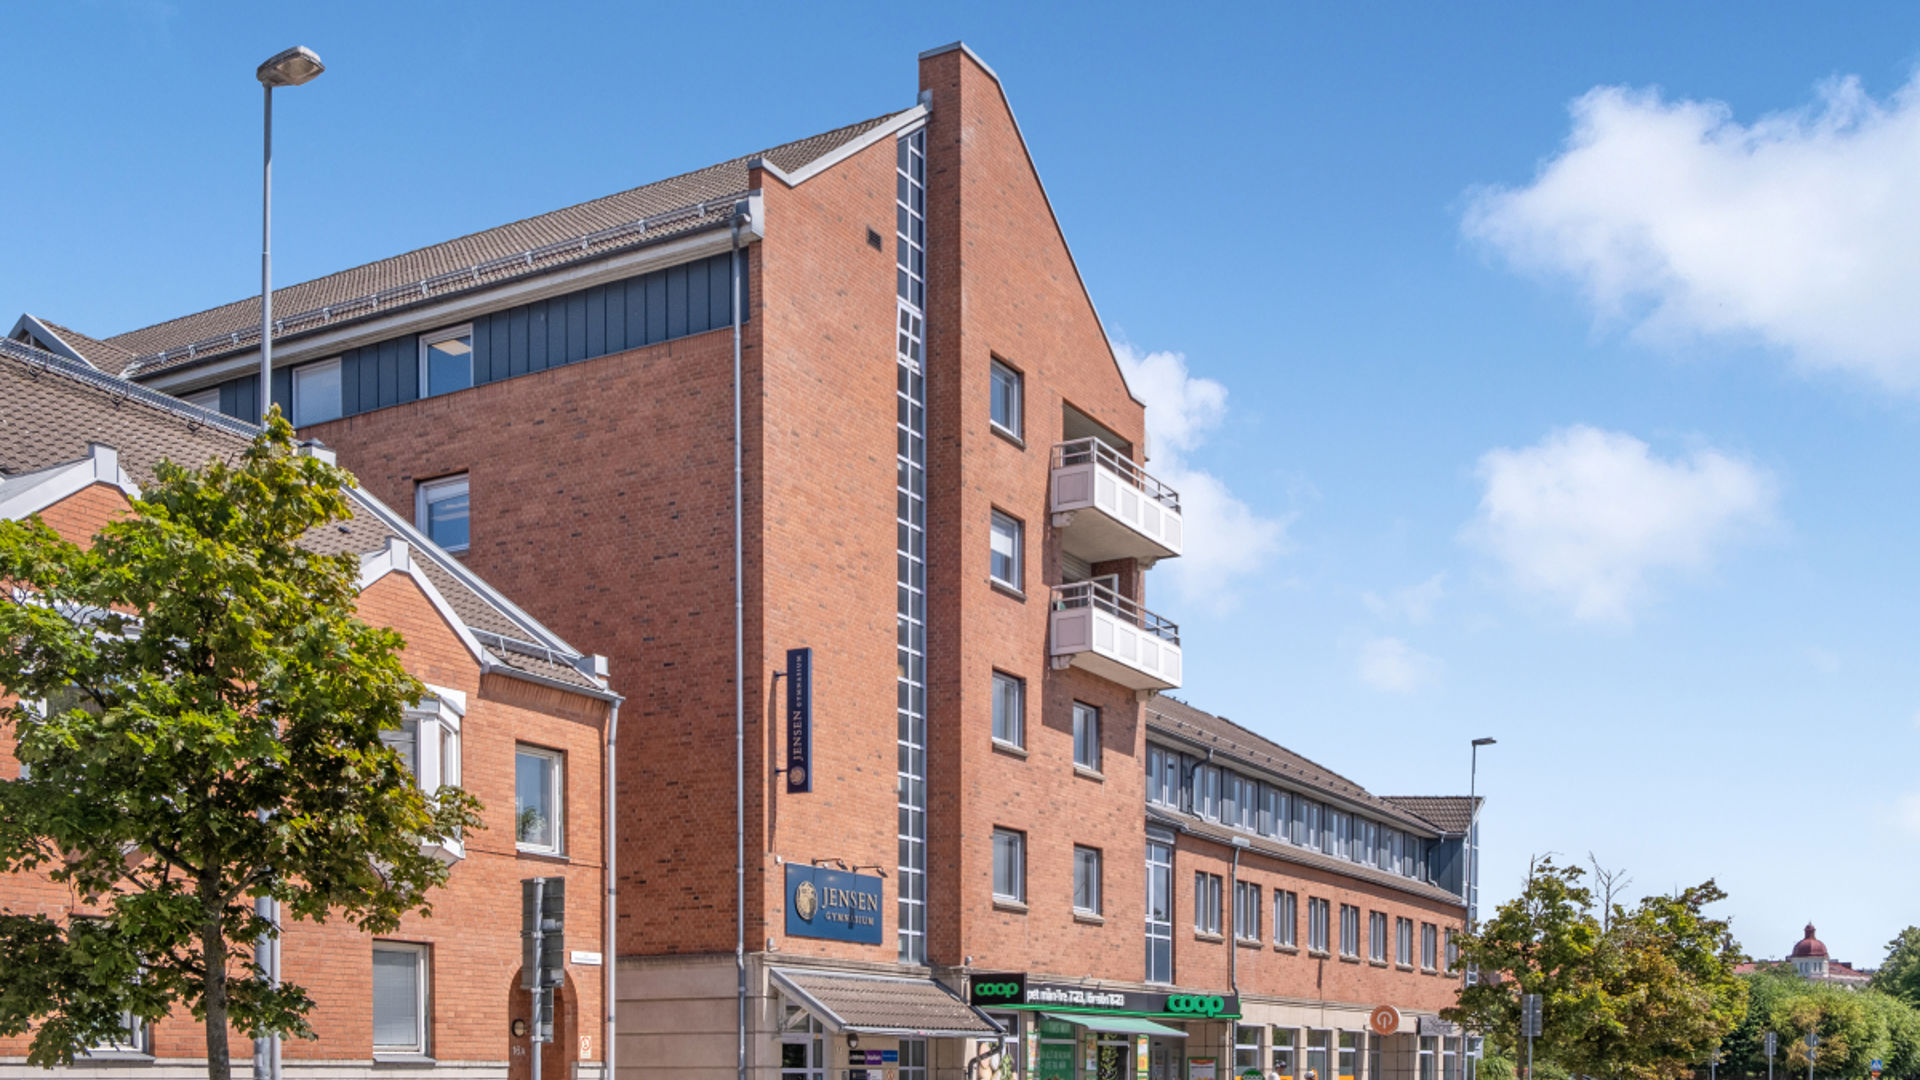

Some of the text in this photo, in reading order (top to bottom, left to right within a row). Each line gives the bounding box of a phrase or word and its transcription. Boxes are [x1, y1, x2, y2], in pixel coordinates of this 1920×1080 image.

[793, 710, 803, 761] JENSEN
[821, 886, 878, 912] JENSEN
[825, 911, 875, 926] GYMNASIUM
[975, 982, 1019, 998] coop
[1167, 993, 1225, 1018] coop
